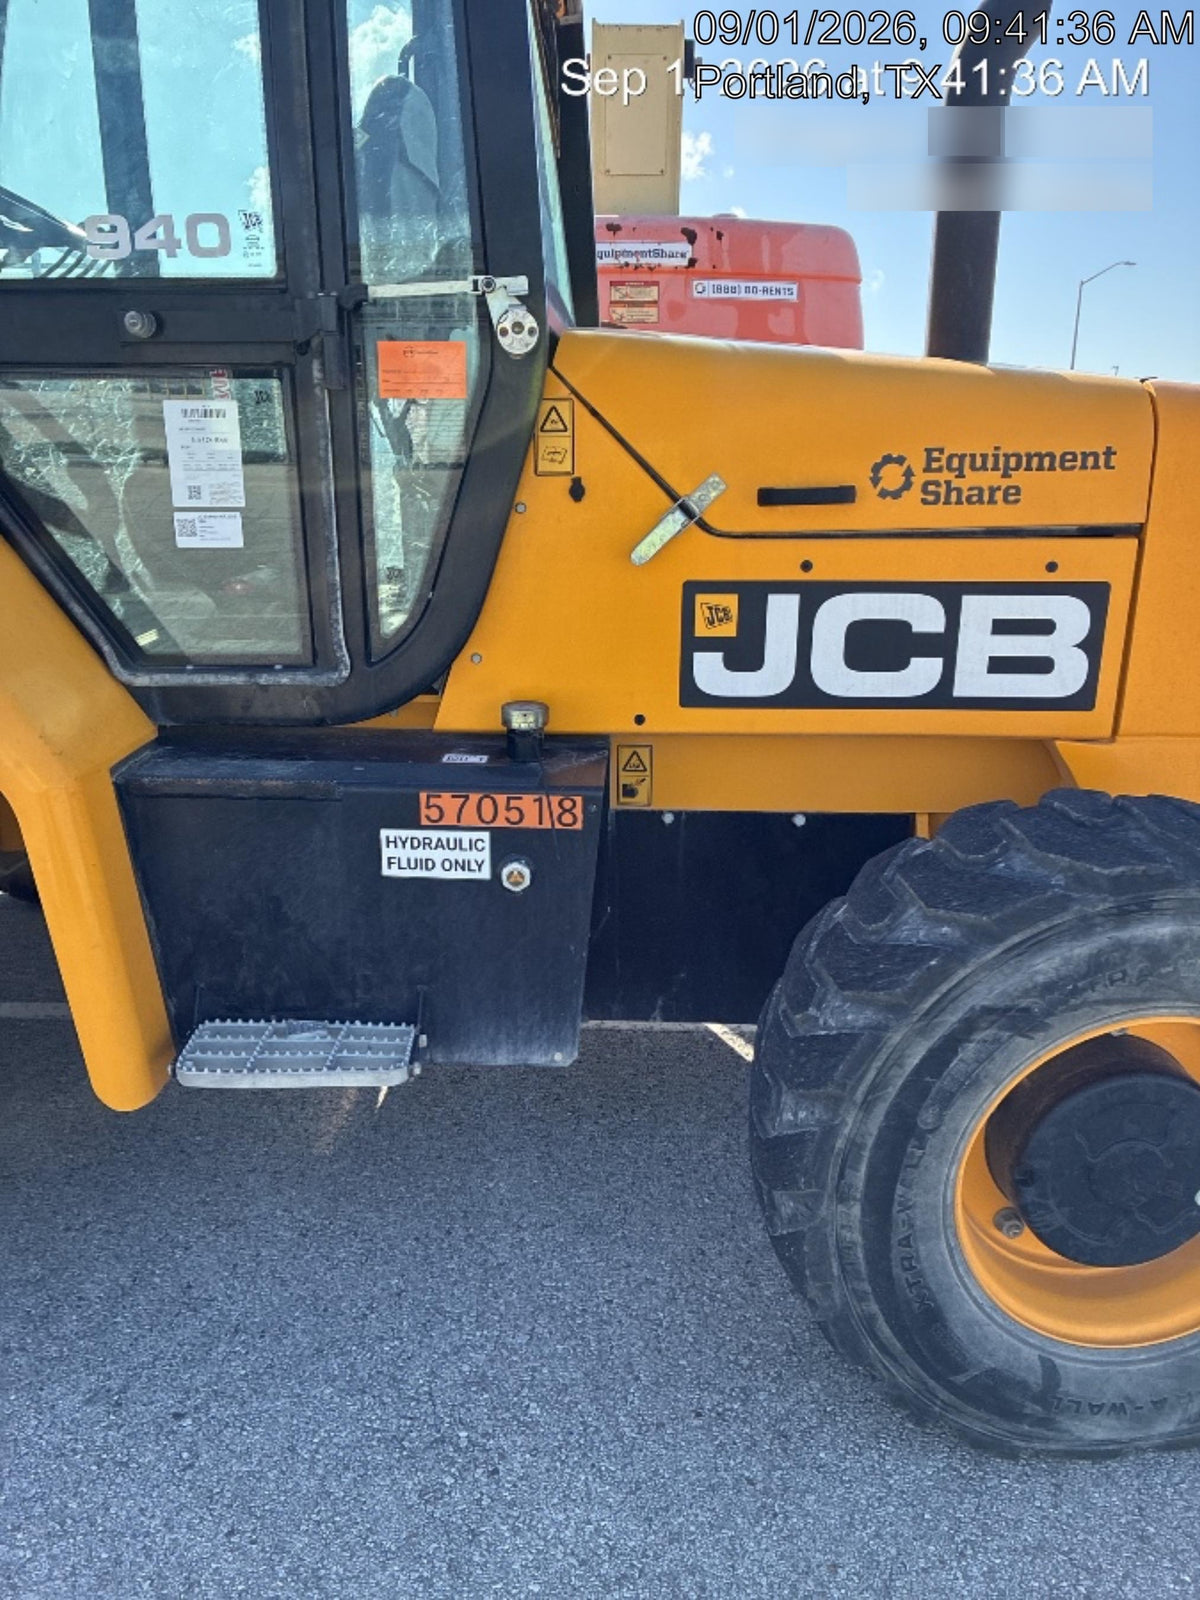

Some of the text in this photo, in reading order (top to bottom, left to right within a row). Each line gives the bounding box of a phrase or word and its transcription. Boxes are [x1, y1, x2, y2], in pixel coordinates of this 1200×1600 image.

[84, 212, 232, 260] 940
[597, 247, 688, 261] quipmentShare
[922, 446, 1117, 478] Equipment
[920, 479, 1022, 506] Share
[692, 592, 1092, 699] JCB
[424, 793, 579, 828] 570518
[385, 835, 486, 852] HYDRAULIC
[386, 856, 486, 873] FLUID ONLY
